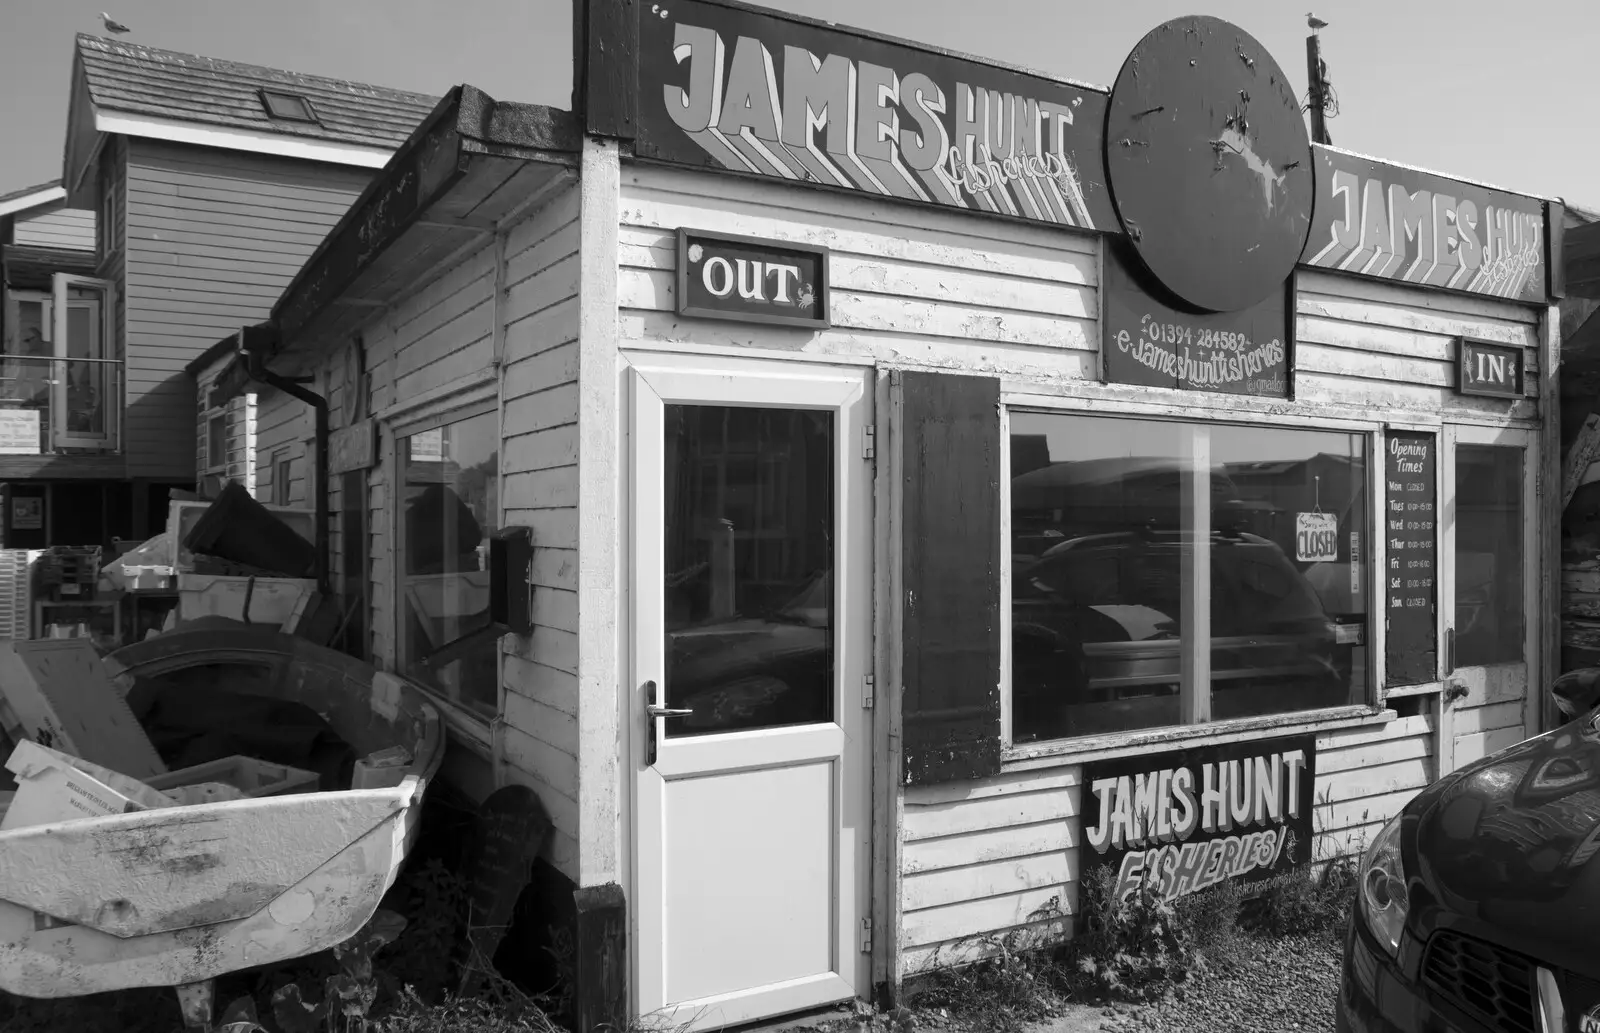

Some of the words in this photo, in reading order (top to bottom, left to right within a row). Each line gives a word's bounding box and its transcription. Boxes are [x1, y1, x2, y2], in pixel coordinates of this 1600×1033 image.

[702, 256, 799, 304] OUT
[1476, 352, 1506, 384] IN
[1390, 437, 1427, 460] Opening
[1396, 457, 1424, 473] Times
[1389, 480, 1402, 491] Mon
[1390, 499, 1404, 511] Tues
[1390, 519, 1404, 530] Wed
[1297, 530, 1336, 558] CLOSED
[1391, 556, 1400, 569] Fri
[1391, 577, 1401, 588] Sat
[1391, 596, 1403, 607] Sun
[1086, 767, 1194, 853] JAMES
[1201, 749, 1307, 832] HUNT
